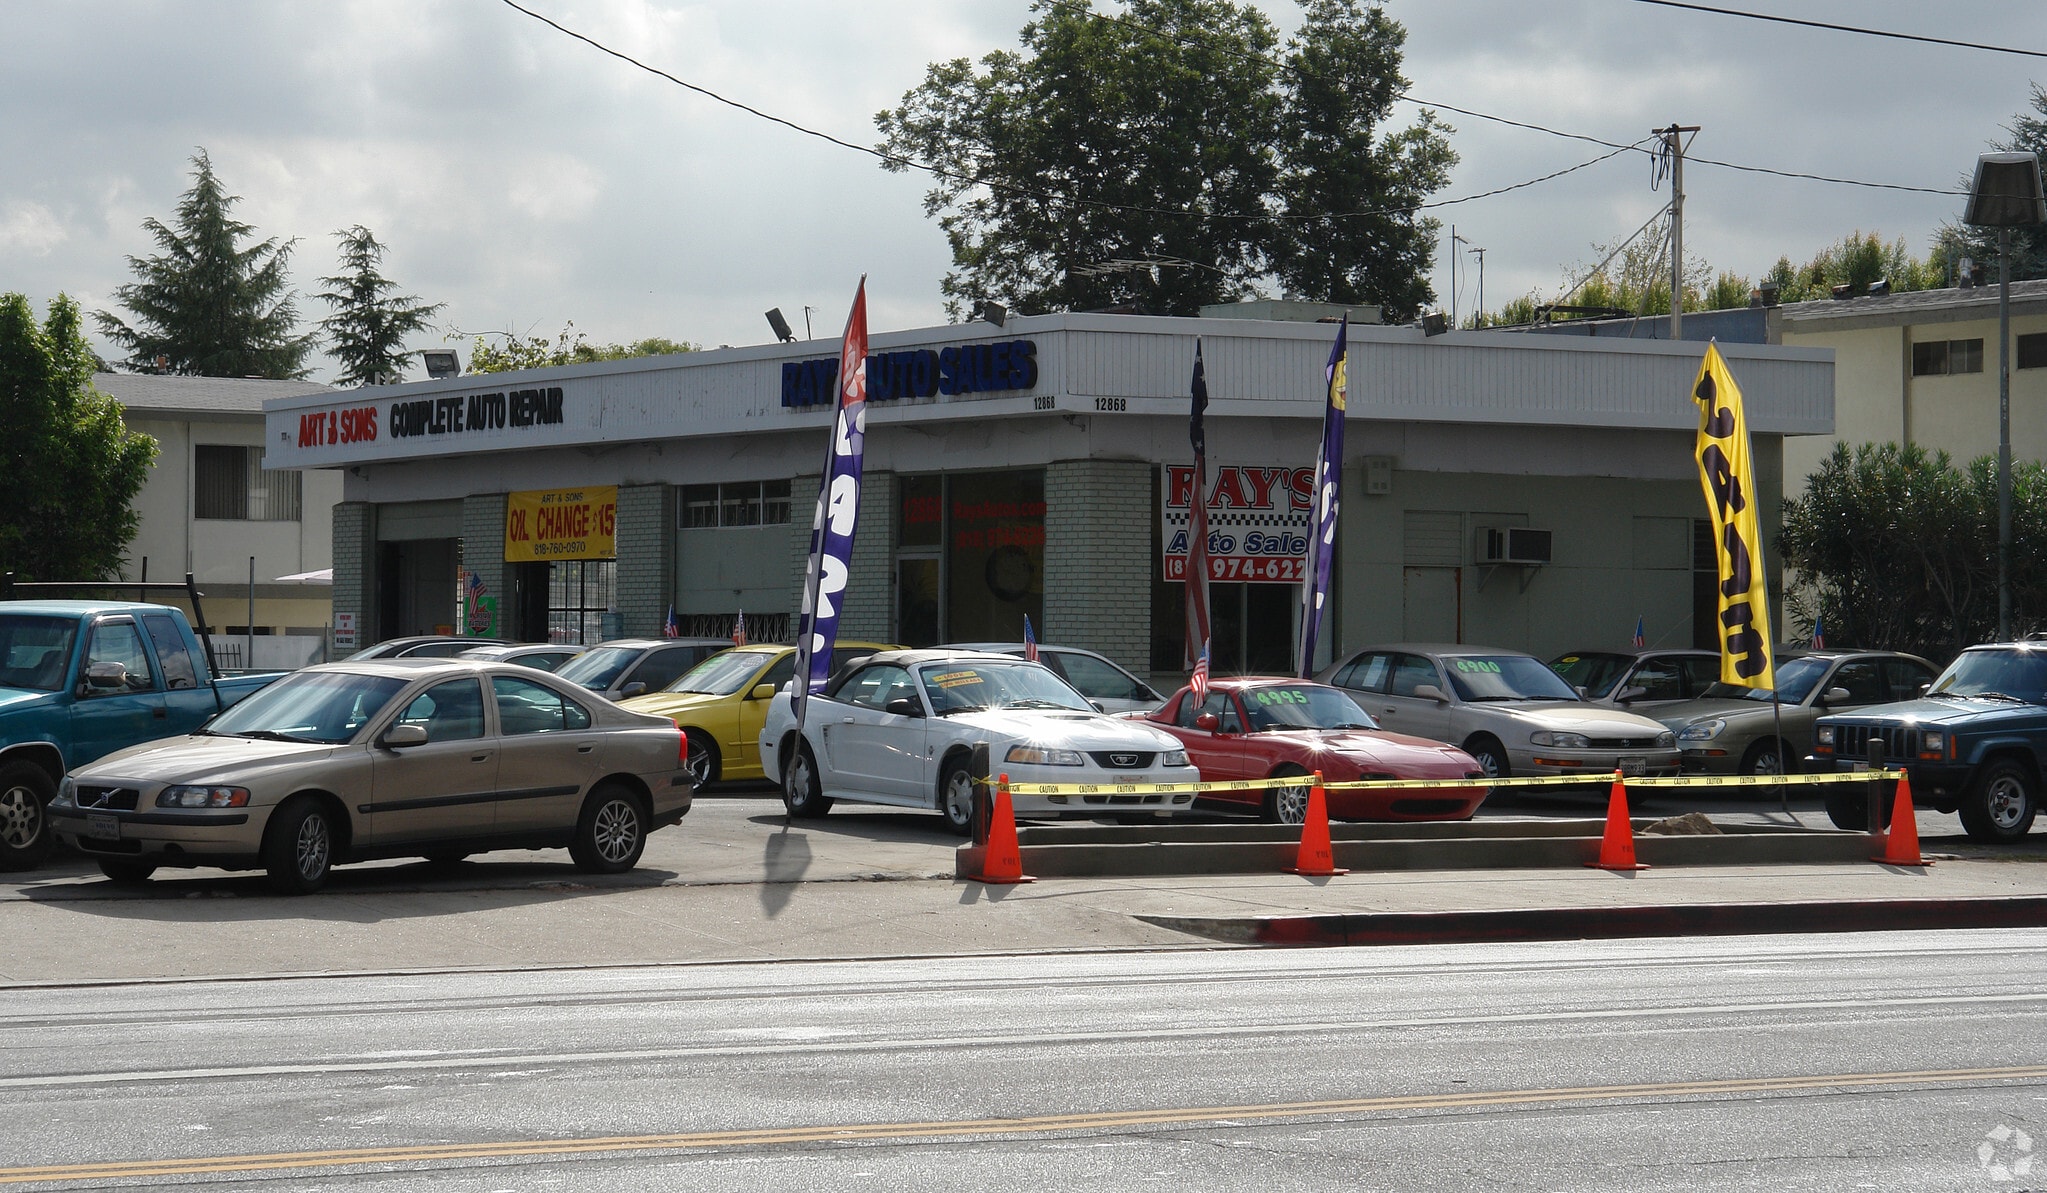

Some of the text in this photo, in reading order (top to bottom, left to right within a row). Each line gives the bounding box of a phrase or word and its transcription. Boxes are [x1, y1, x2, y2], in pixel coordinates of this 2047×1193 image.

[940, 340, 1037, 395] SALES
[1034, 396, 1055, 410] 12868
[1095, 398, 1126, 411] 12868
[390, 387, 563, 438] COMPLETE AUTO REPAIR
[299, 407, 377, 448] ART & SONS
[541, 494, 555, 504] ART
[565, 493, 583, 501] SONS
[510, 509, 529, 542] OIL
[537, 504, 590, 540] CHANGE
[535, 541, 586, 555] 818-760-0970
[1166, 529, 1307, 555] Ato Sale
[1213, 559, 1305, 579] 974-622
[1456, 660, 1501, 673] 4900
[1256, 690, 1308, 706] 4995
[1039, 785, 1058, 793] CAUTION
[1079, 785, 1098, 793] CAUTION
[1156, 784, 1175, 792] CAUTION
[1193, 783, 1212, 791] CAUTION
[1231, 782, 1250, 790] CAUTION
